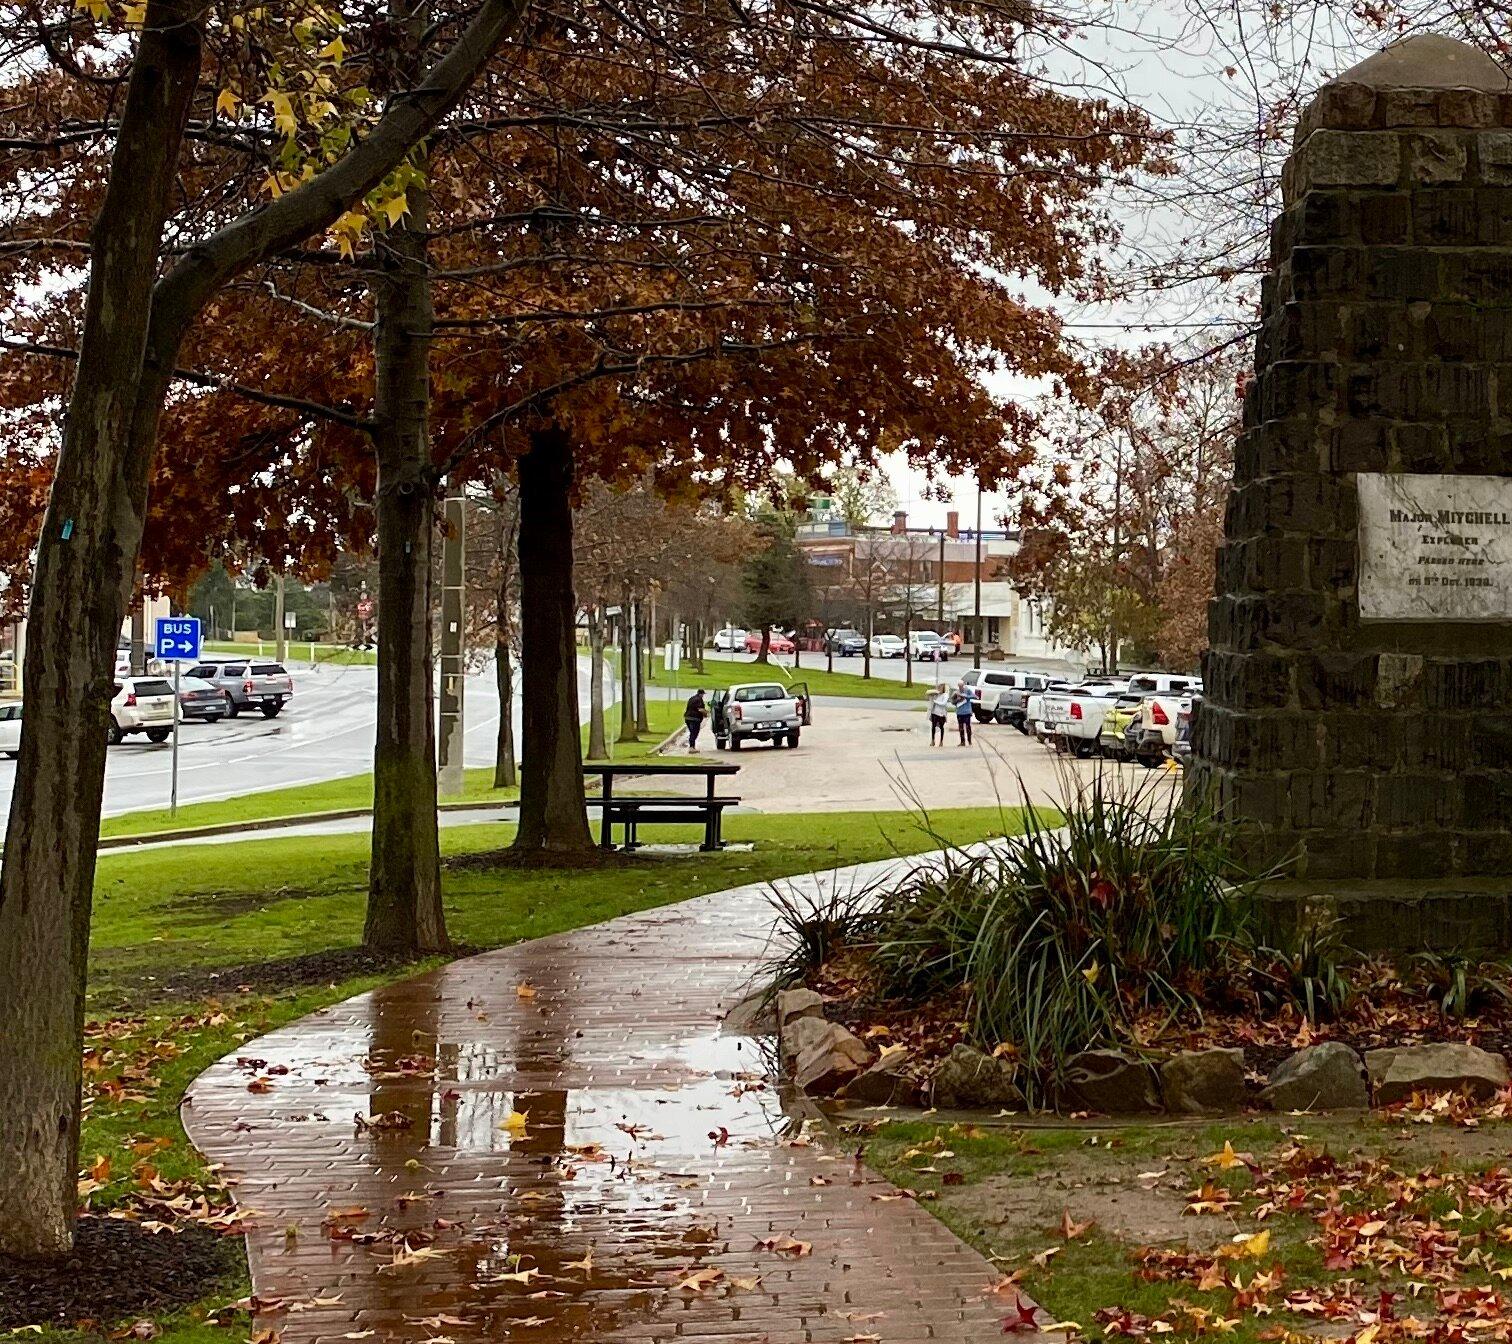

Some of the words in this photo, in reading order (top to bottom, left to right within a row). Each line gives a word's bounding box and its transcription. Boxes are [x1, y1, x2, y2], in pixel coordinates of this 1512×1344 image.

[1390, 509, 1431, 523] MAJOR
[1437, 510, 1510, 524] MITCHELL
[163, 623, 192, 634] BUS
[160, 638, 175, 654] P
